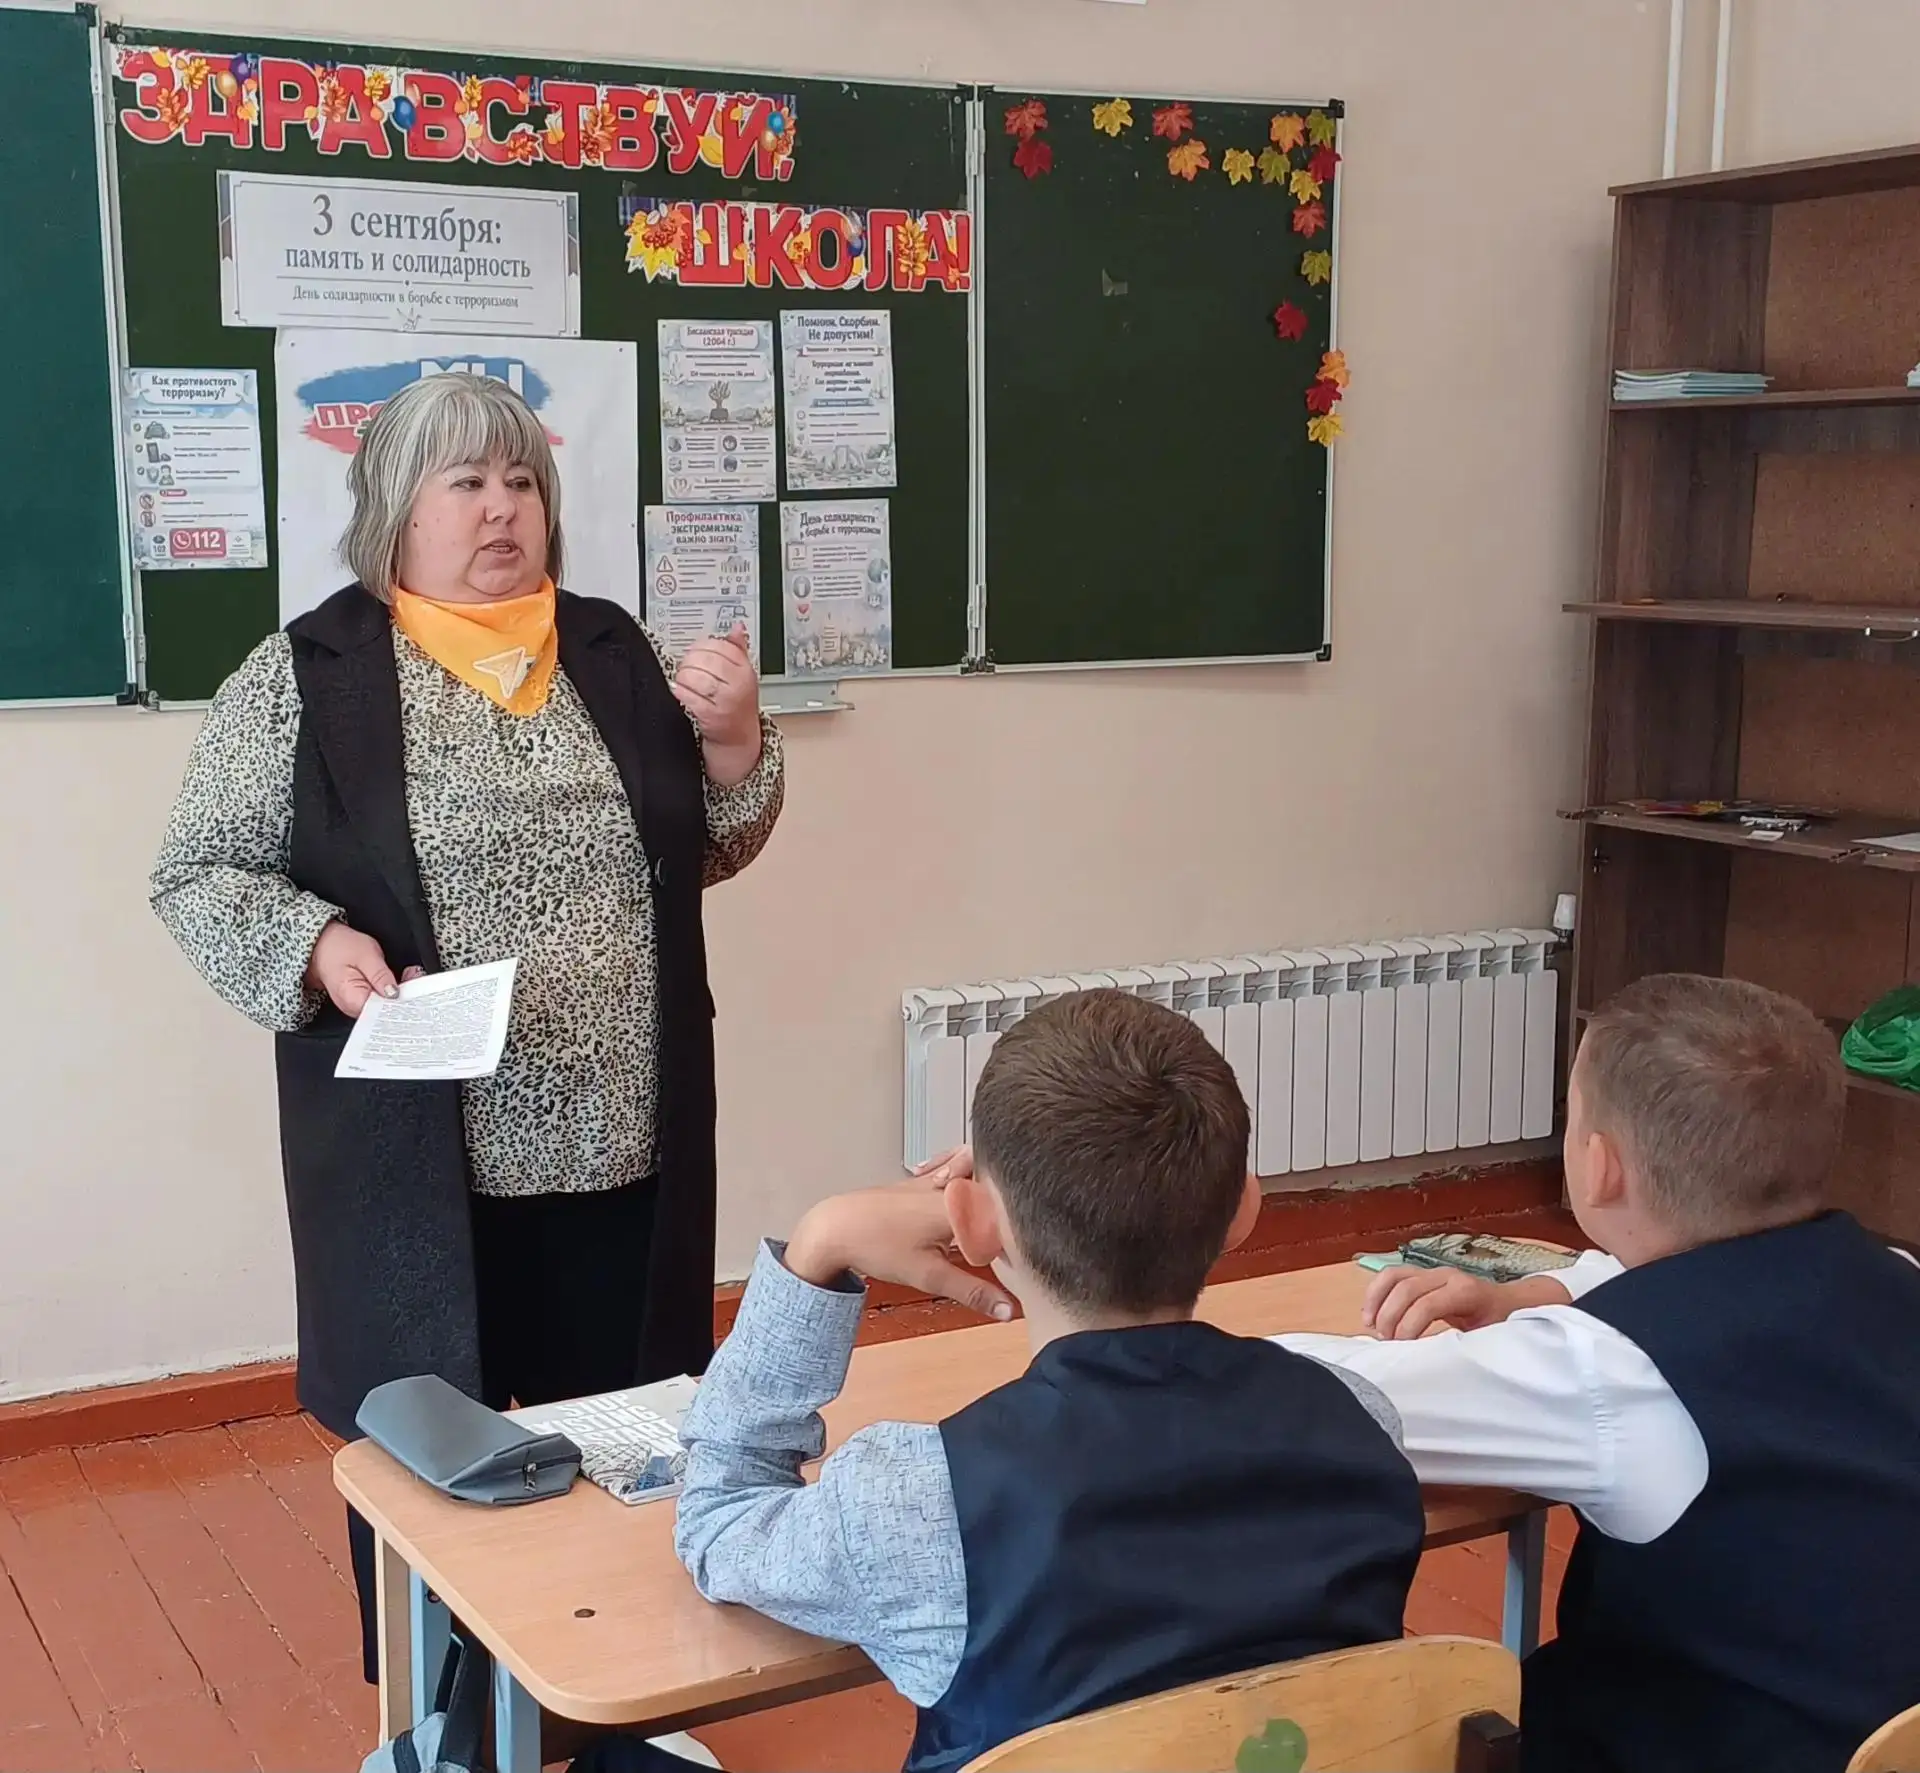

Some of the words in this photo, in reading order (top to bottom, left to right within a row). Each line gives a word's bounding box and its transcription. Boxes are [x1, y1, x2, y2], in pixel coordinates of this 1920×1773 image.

[121, 50, 795, 180] ЗДРАВСТВУЙ,
[312, 194, 333, 236] 3
[350, 207, 502, 252] сентября:
[676, 202, 973, 292] ШКОЛА!
[286, 247, 364, 271] память
[372, 251, 385, 272] и
[392, 250, 531, 281] солидарность
[293, 285, 320, 302] День
[323, 289, 395, 305] солидарности
[408, 291, 443, 308] борьбе
[445, 295, 452, 305] с
[808, 329, 821, 340] Не
[823, 328, 874, 344] допустим!
[152, 375, 169, 385] Как
[161, 387, 226, 400] терроризму?
[666, 511, 742, 524] Профилактика
[671, 523, 744, 535] экстремизма:
[192, 531, 221, 548] 112
[676, 534, 706, 544] важно
[708, 533, 737, 543] знать!
